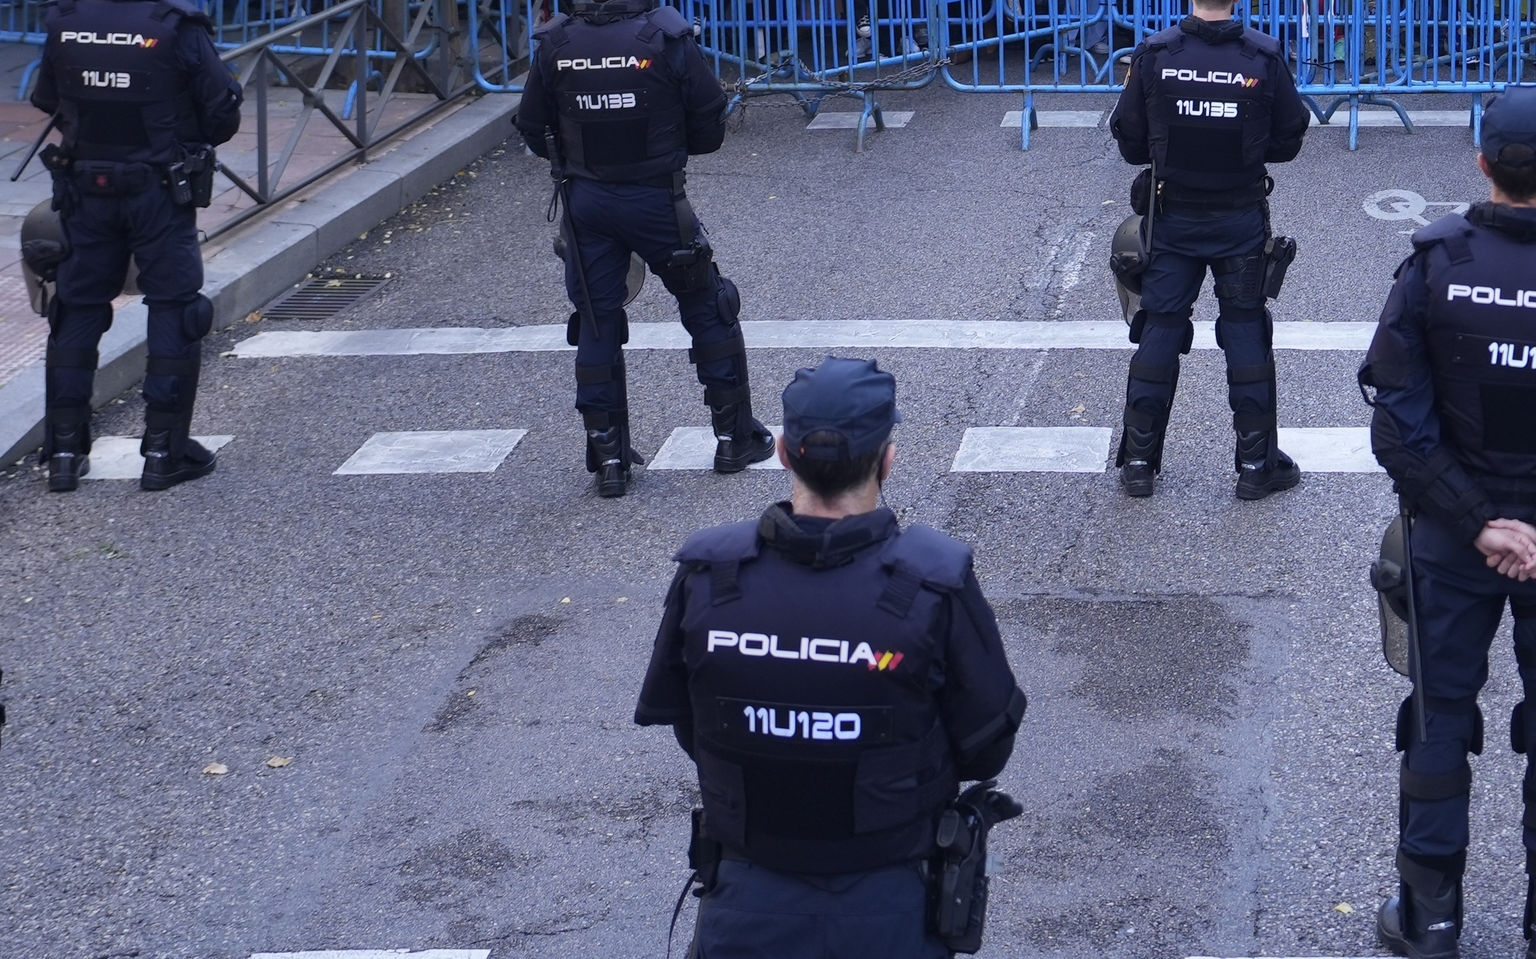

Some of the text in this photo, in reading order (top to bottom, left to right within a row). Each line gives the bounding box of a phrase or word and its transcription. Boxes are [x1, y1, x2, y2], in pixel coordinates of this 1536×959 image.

[60, 31, 146, 47] POLICIA
[556, 55, 639, 71] POLICIA
[81, 70, 131, 89] 11U13
[1161, 68, 1246, 84] POLICIA
[575, 92, 636, 110] 11U133
[1176, 99, 1238, 118] 11U135
[707, 630, 877, 665] POLICIA
[743, 705, 861, 740] 11U120
